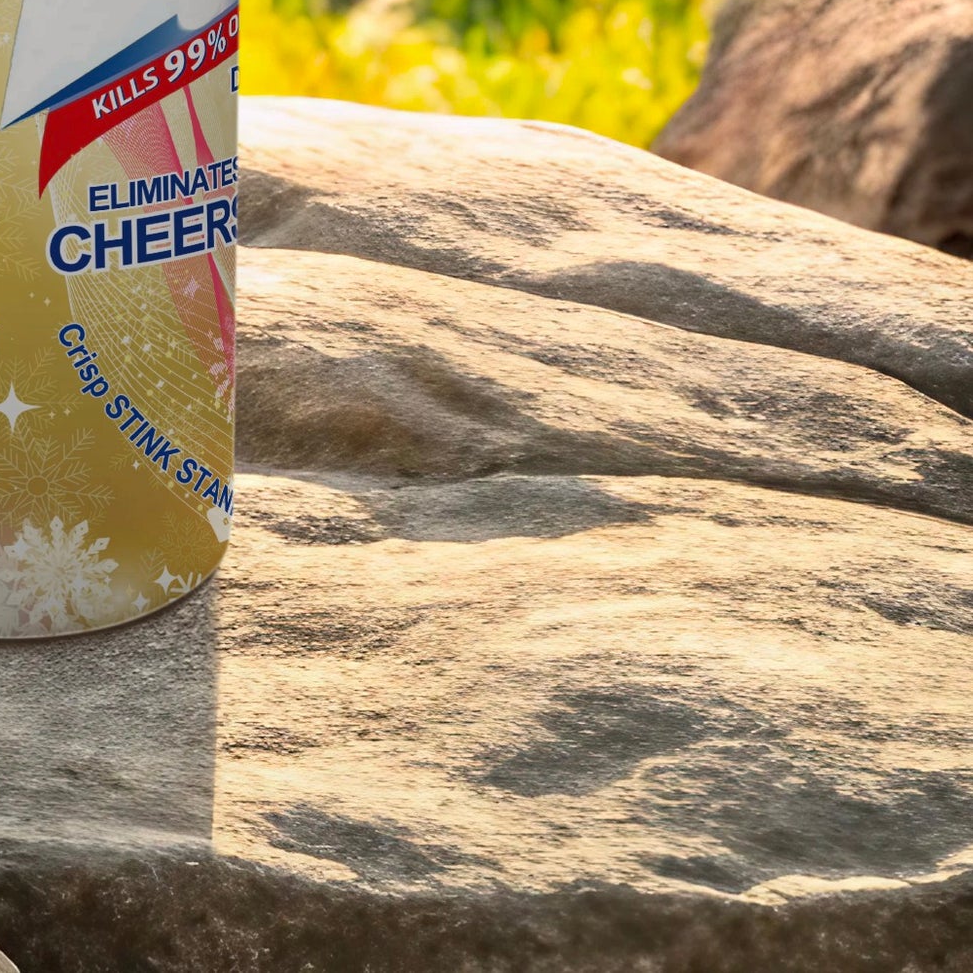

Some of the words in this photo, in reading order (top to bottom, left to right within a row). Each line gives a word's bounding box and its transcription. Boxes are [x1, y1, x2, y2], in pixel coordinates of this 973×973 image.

[91, 66, 159, 120] KILLS
[163, 23, 227, 83] 99%
[58, 323, 109, 398] Crisp
[104, 394, 181, 472] STINK
[175, 458, 234, 516] STAN
